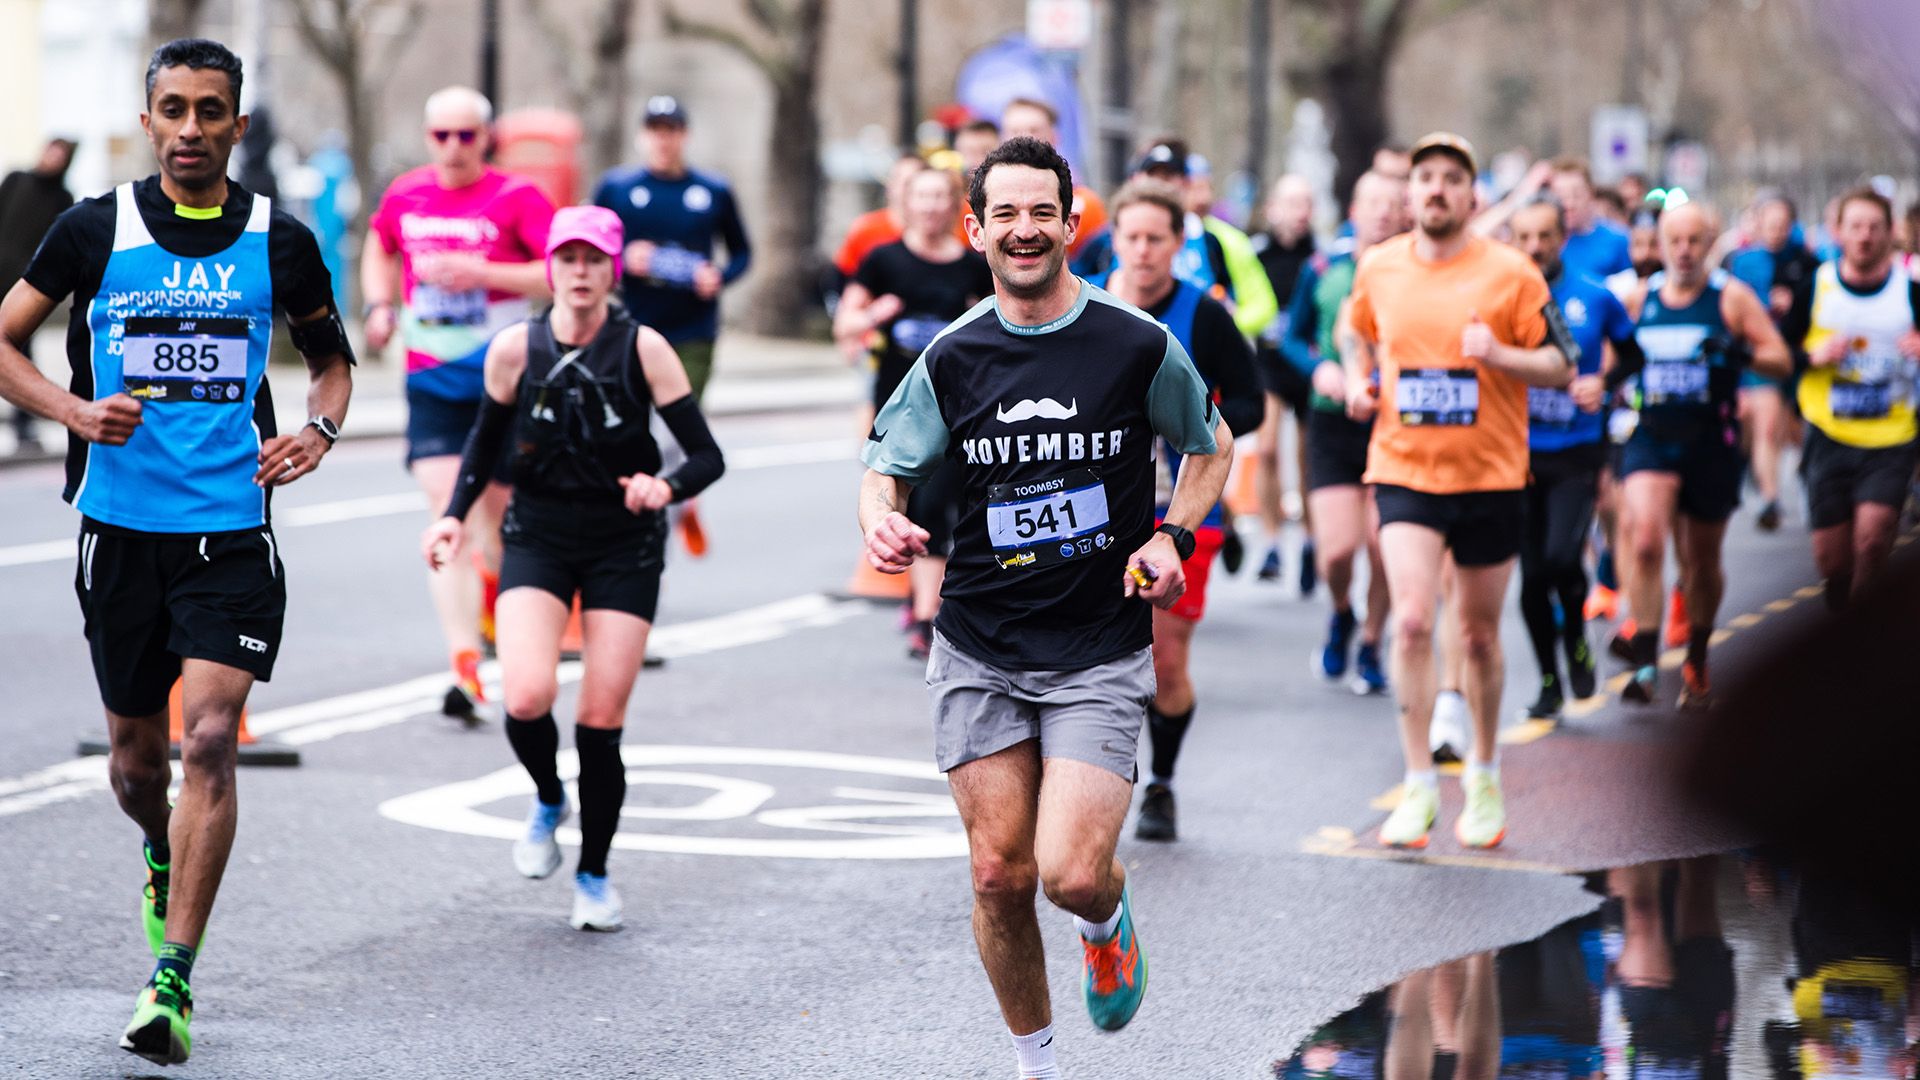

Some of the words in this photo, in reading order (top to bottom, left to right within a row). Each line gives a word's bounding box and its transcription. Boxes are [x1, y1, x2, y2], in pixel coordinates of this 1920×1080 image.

[163, 261, 236, 291] JAY
[109, 289, 229, 310] PARKINSON'S
[178, 321, 197, 332] JAY
[153, 343, 219, 373] 885
[1014, 478, 1065, 497] TOOMBSY
[1014, 499, 1078, 539] 541
